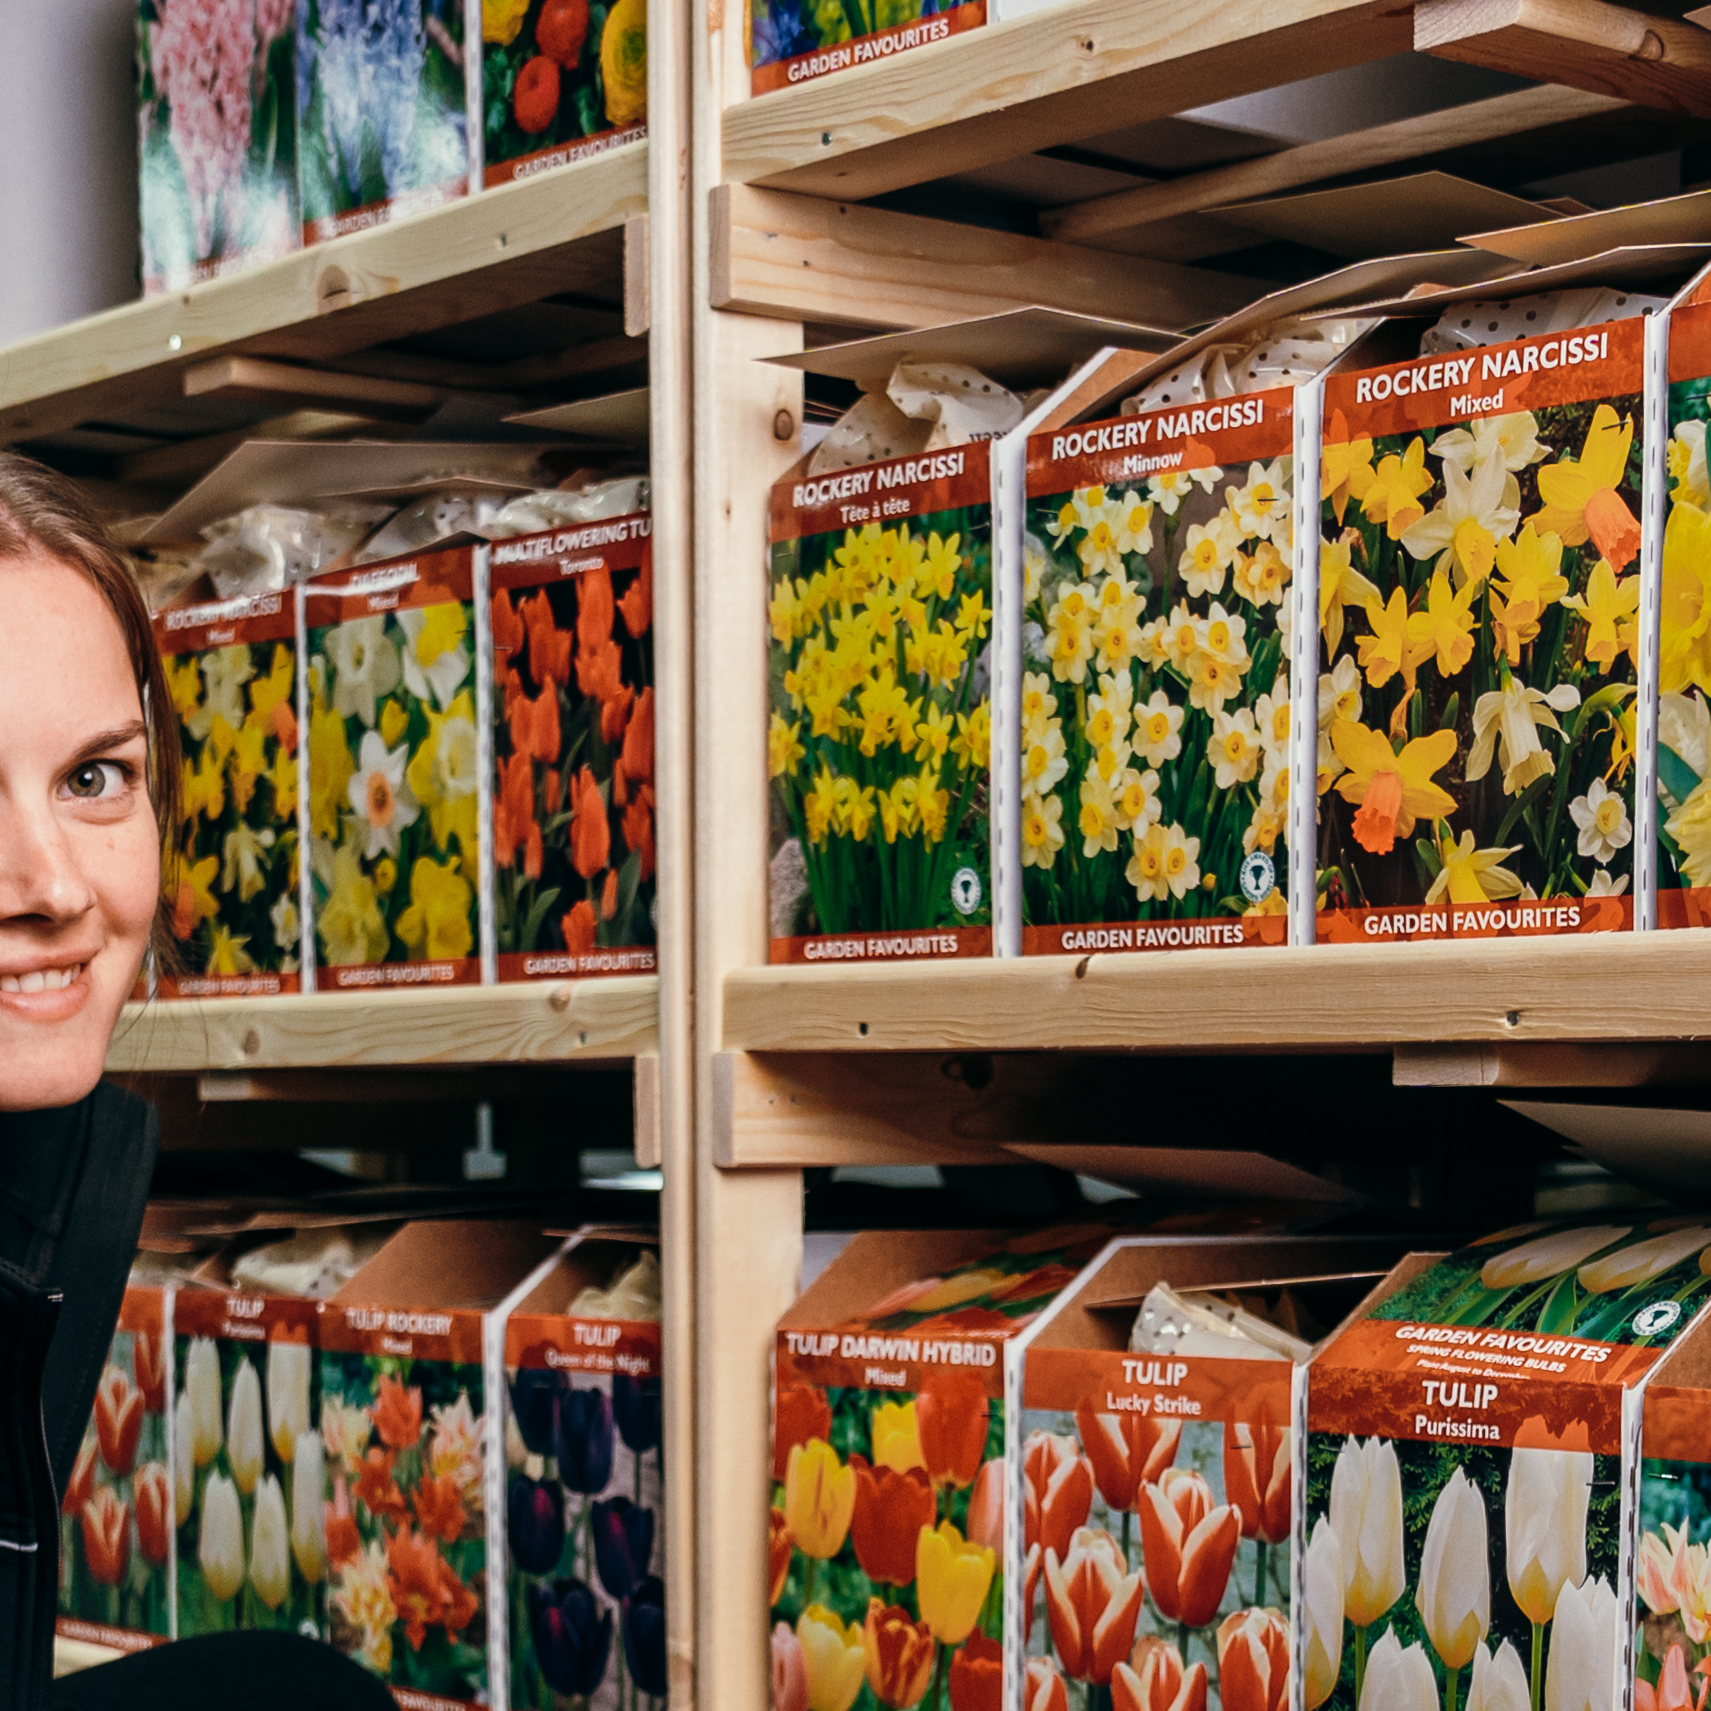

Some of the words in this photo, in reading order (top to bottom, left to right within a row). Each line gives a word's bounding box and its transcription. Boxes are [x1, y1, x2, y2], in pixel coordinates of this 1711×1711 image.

[788, 45, 850, 83] GARDEN
[853, 20, 950, 66] FAVOURITES
[1357, 359, 1475, 402] ROCKERY
[1481, 332, 1608, 380] NARCISSI
[1450, 389, 1504, 417] Mixed
[1051, 420, 1151, 460] ROCKERY
[1157, 400, 1264, 442] NARCISSI
[1123, 451, 1183, 475] Minnow
[792, 471, 873, 507] ROCKERY
[877, 453, 964, 491] NARCISSI
[840, 503, 869, 523] Tête
[873, 500, 883, 518] à
[886, 495, 910, 516] tête
[493, 525, 623, 565] MULTIFLOWERING
[1364, 910, 1452, 937] GARDEN
[1456, 905, 1580, 931] FAVOURITES
[803, 937, 864, 962] GARDEN
[866, 933, 959, 959] FAVOURITES
[1060, 927, 1132, 951] GARDEN
[1135, 923, 1244, 948] FAVOURITES
[524, 957, 577, 975] GARDEN
[579, 952, 655, 972] FAVOURITES
[574, 1325, 620, 1345] TULIP
[1396, 1326, 1482, 1346] GARDEN
[1481, 1333, 1611, 1362] FAVOURITES
[787, 1332, 839, 1357] TULIP
[841, 1336, 919, 1363] DARWIN
[922, 1342, 996, 1367] HYBRID
[1407, 1345, 1450, 1357] SPRING
[1451, 1349, 1524, 1367] FLOWERING
[1525, 1359, 1567, 1373] BULBS
[865, 1368, 906, 1387] Mixed
[1122, 1359, 1188, 1386] TULIP
[1439, 1364, 1470, 1374] August
[1107, 1393, 1150, 1417] Lucky
[1153, 1395, 1202, 1416] Strike
[1422, 1382, 1498, 1410] TULIP
[1415, 1415, 1500, 1441] Purissima
